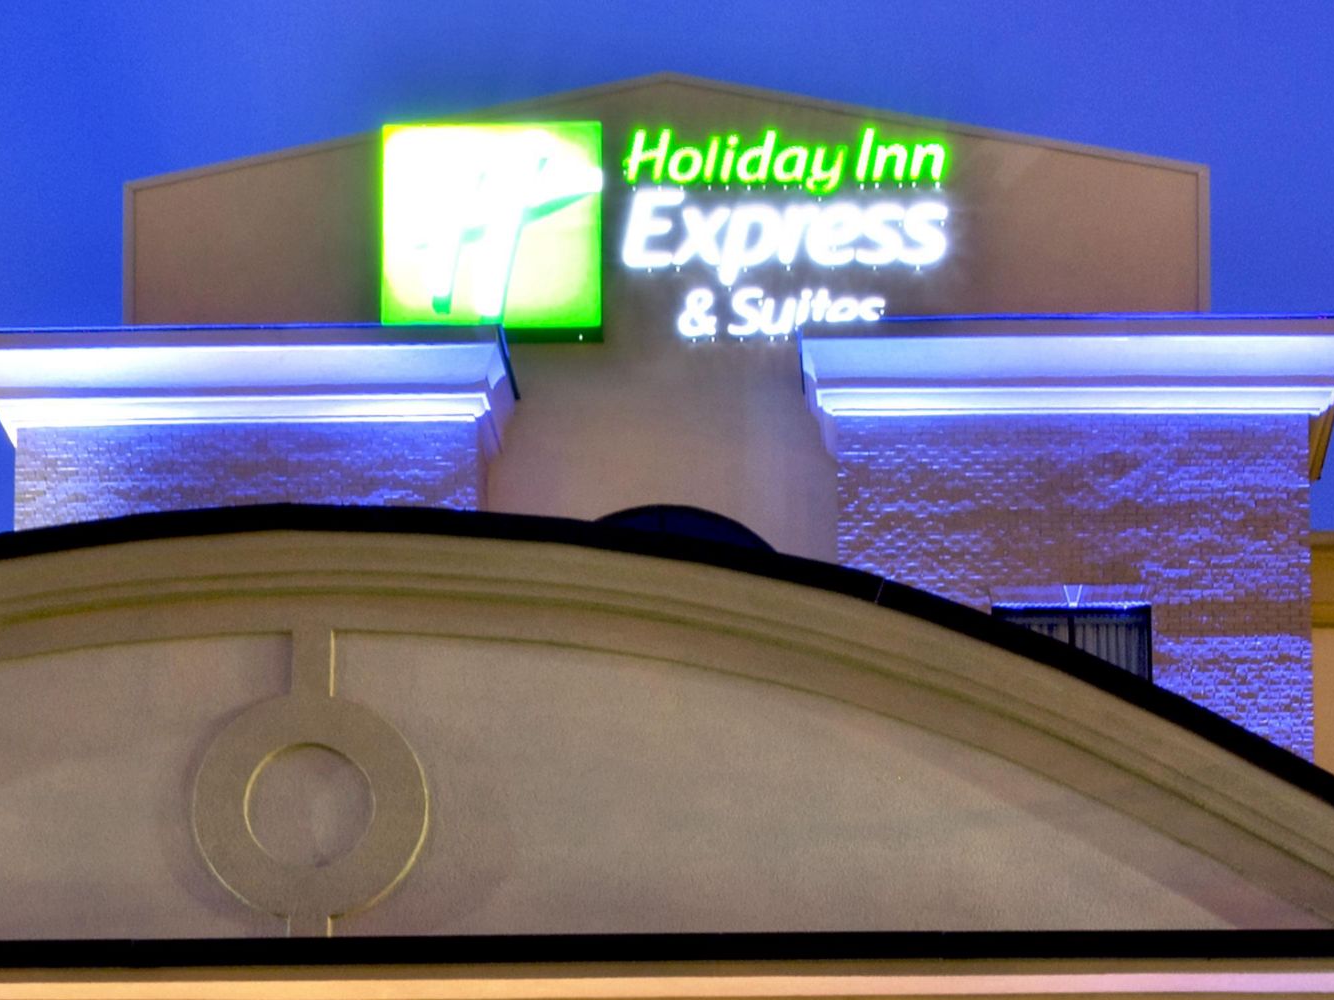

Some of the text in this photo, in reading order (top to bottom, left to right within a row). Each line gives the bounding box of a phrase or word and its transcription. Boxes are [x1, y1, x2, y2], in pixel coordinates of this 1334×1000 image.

[624, 126, 948, 193] Holiday Inn
[623, 189, 949, 286] Express
[678, 288, 716, 336] &
